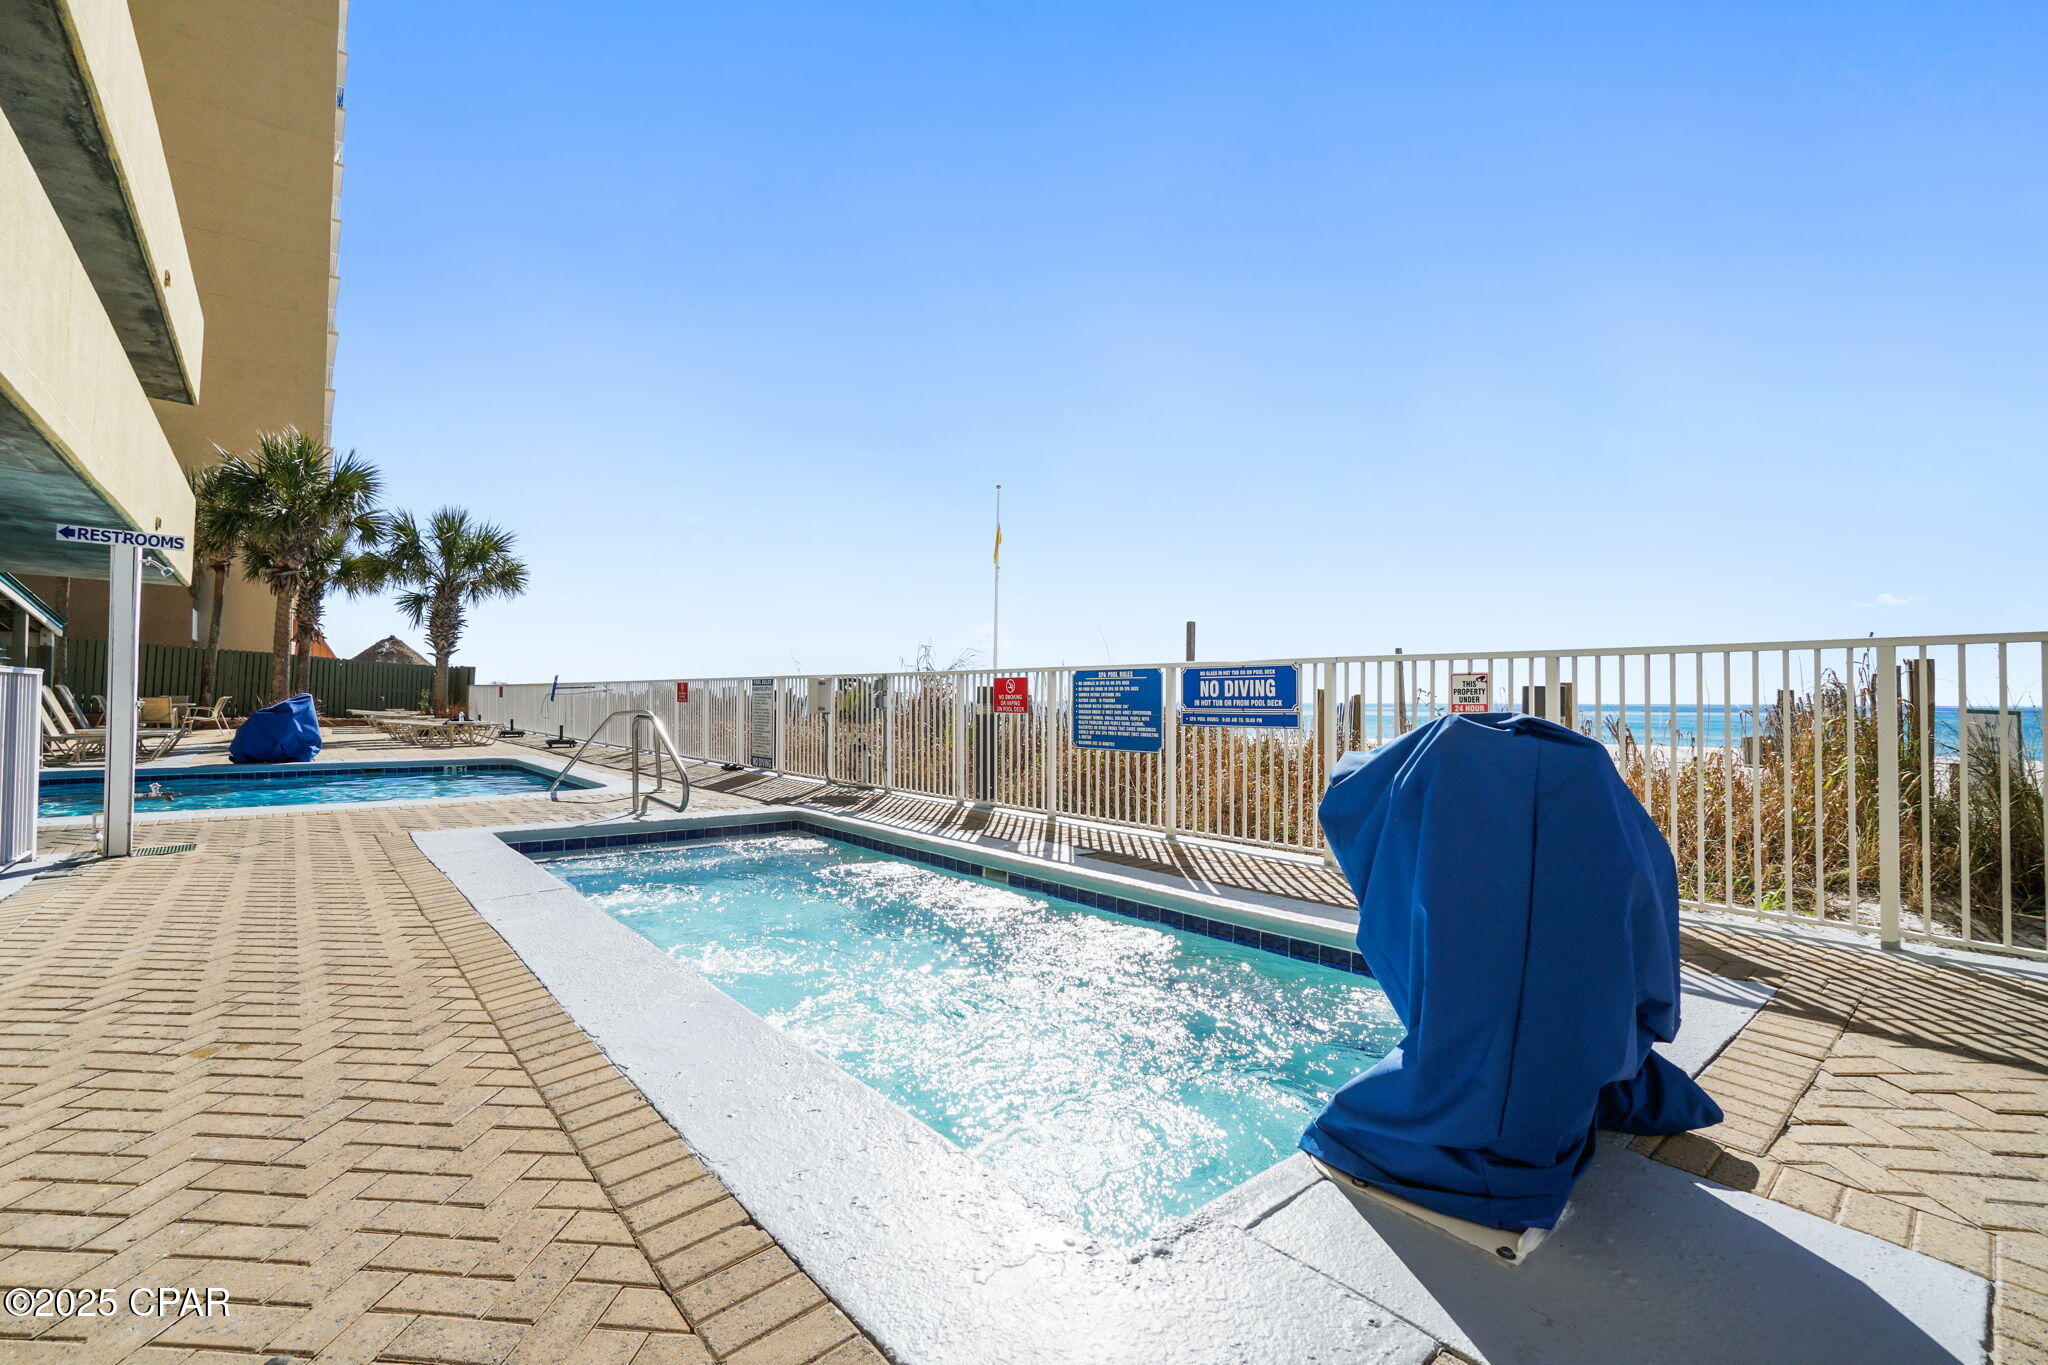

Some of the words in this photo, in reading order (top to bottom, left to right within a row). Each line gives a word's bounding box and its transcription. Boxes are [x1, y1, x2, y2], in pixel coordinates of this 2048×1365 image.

[77, 527, 184, 549] RESTROOMS
[1200, 680, 1219, 697] NO
[1224, 679, 1276, 697] DIVING
